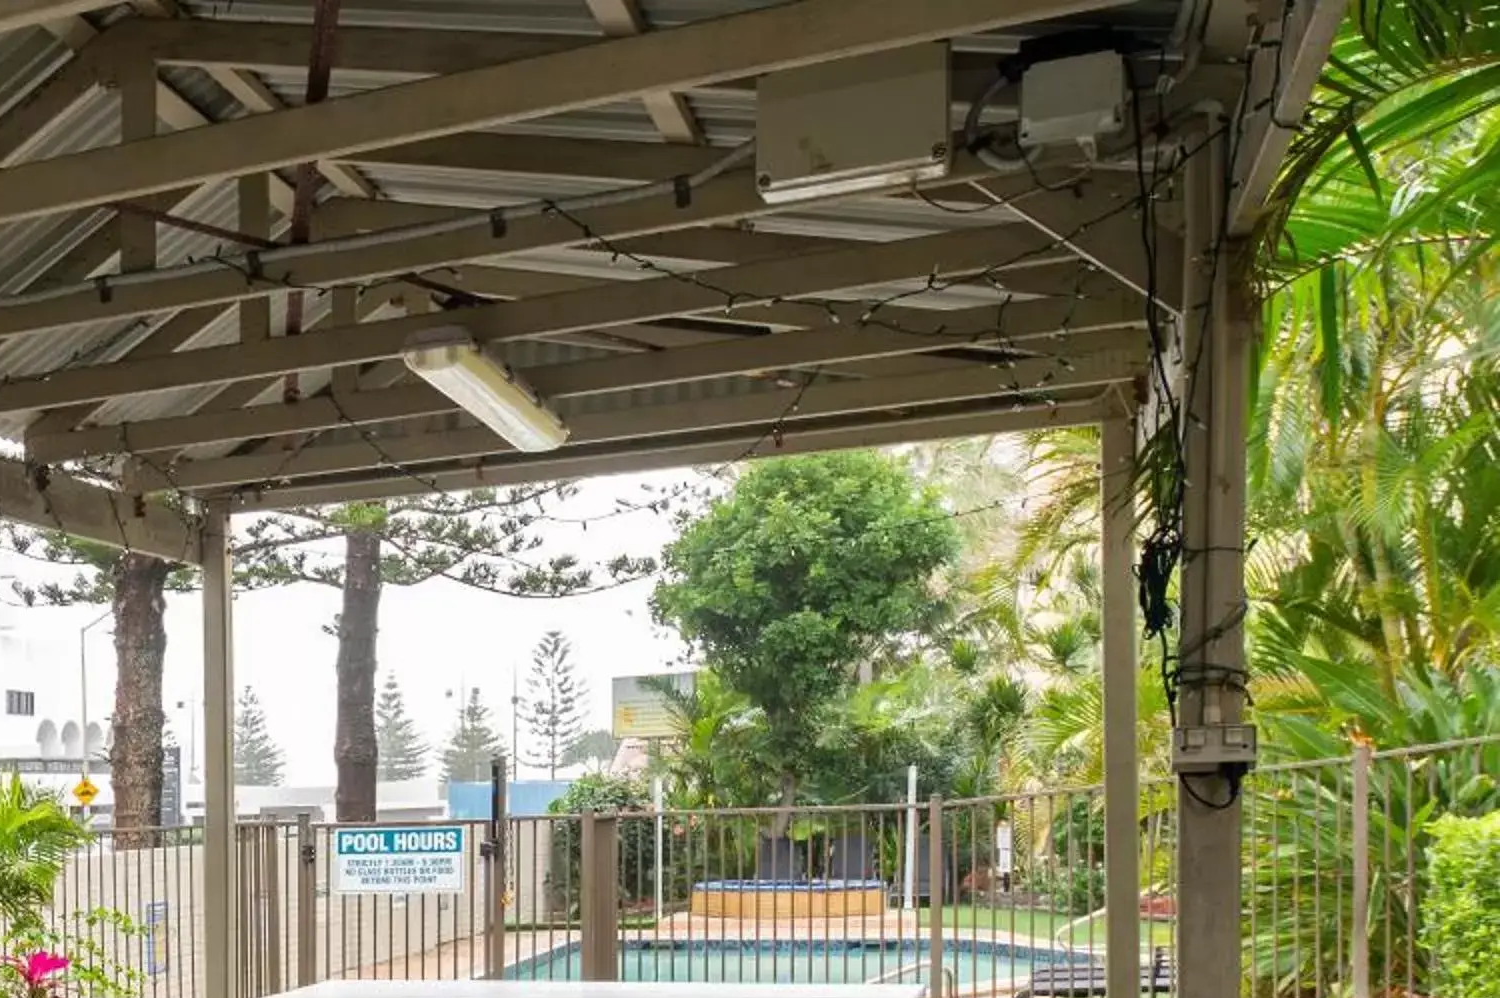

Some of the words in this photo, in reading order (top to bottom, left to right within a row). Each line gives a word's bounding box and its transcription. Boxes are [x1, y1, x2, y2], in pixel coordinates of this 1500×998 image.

[341, 833, 389, 852] POOL
[393, 831, 457, 851] HOURS
[413, 874, 438, 884] POINT
